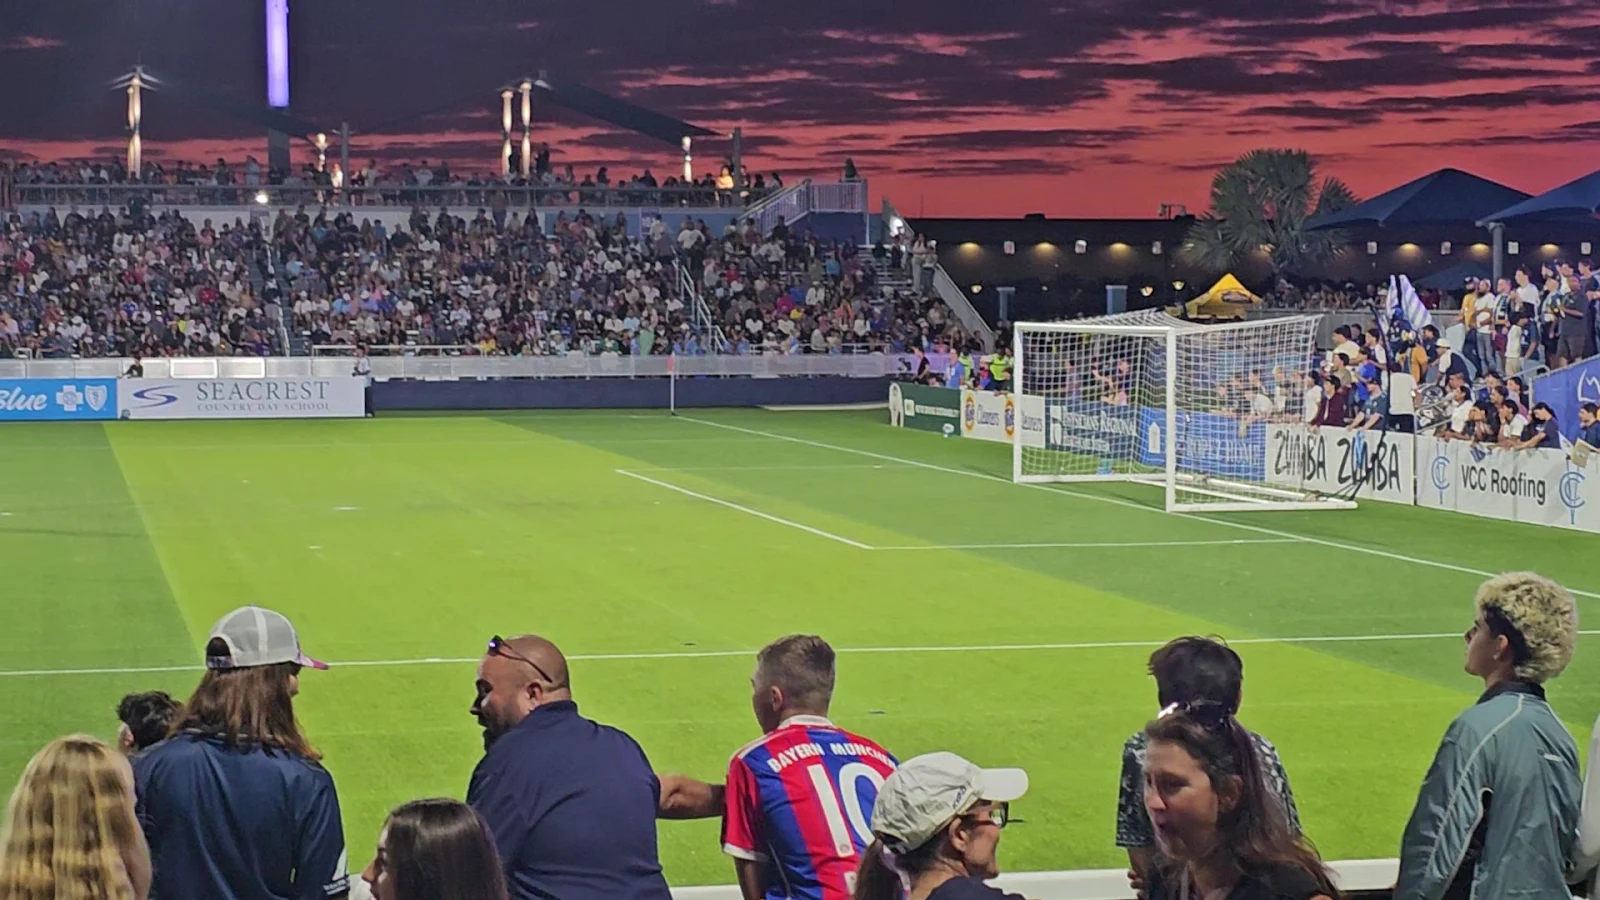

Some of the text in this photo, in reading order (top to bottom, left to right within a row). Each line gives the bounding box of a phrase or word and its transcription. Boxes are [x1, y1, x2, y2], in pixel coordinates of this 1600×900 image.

[196, 381, 330, 401] SEACREST
[197, 402, 330, 412] COUNTRY DAY SCHOOL
[1274, 429, 1327, 482] ZUMBA
[1336, 436, 1401, 493] ZUMBA
[1461, 464, 1487, 491] VCC
[1491, 469, 1546, 505] Roofing
[767, 743, 825, 773] BAYERN
[806, 762, 886, 858] 10
